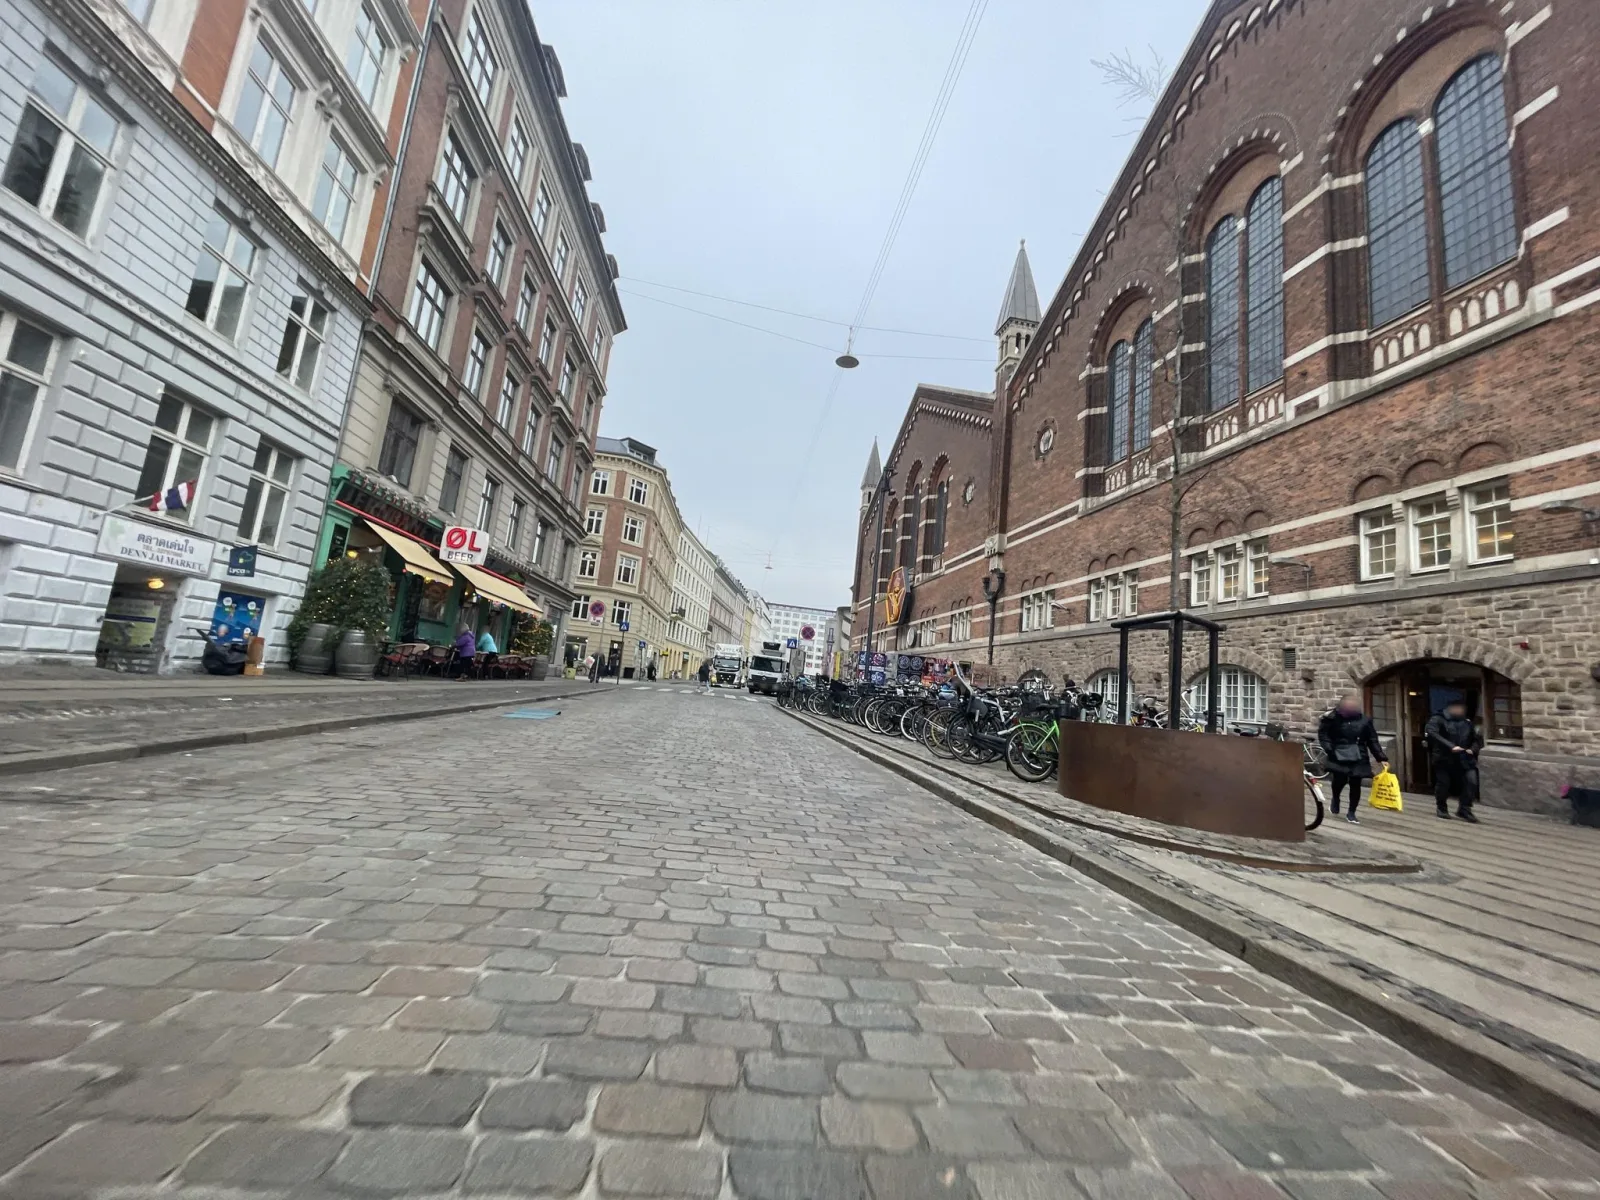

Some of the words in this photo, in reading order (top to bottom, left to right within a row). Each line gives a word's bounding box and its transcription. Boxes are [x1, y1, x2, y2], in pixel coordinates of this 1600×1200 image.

[446, 527, 482, 553] ØL
[120, 546, 147, 558] DENN
[149, 552, 164, 563] JAI
[165, 556, 203, 570] MARKET
[447, 551, 474, 562] BEER
